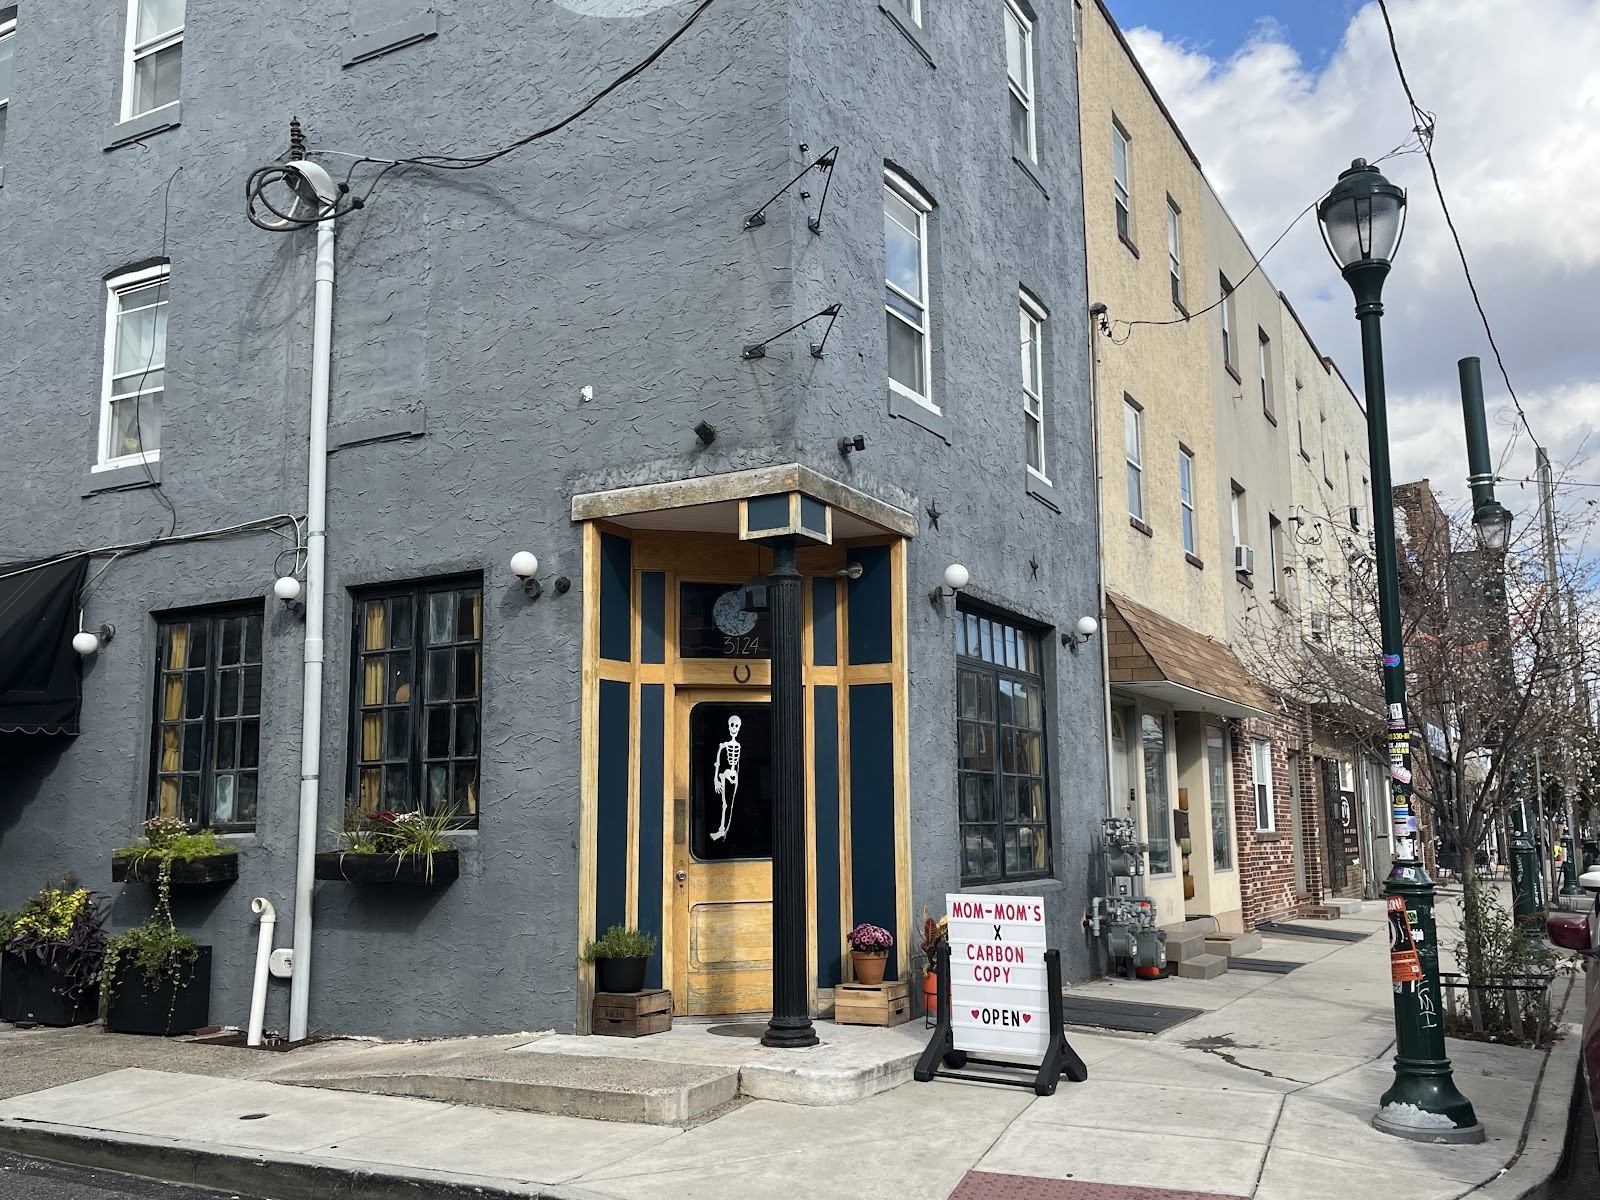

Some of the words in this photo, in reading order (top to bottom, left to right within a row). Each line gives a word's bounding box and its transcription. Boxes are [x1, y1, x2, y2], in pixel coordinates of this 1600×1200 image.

[723, 636, 760, 655] 3124
[952, 902, 1042, 922] MOM-MOM'S
[993, 924, 1002, 941] X
[966, 943, 1025, 963] CARBON
[974, 964, 1011, 984] COPY
[982, 1008, 1020, 1027] OPEN
